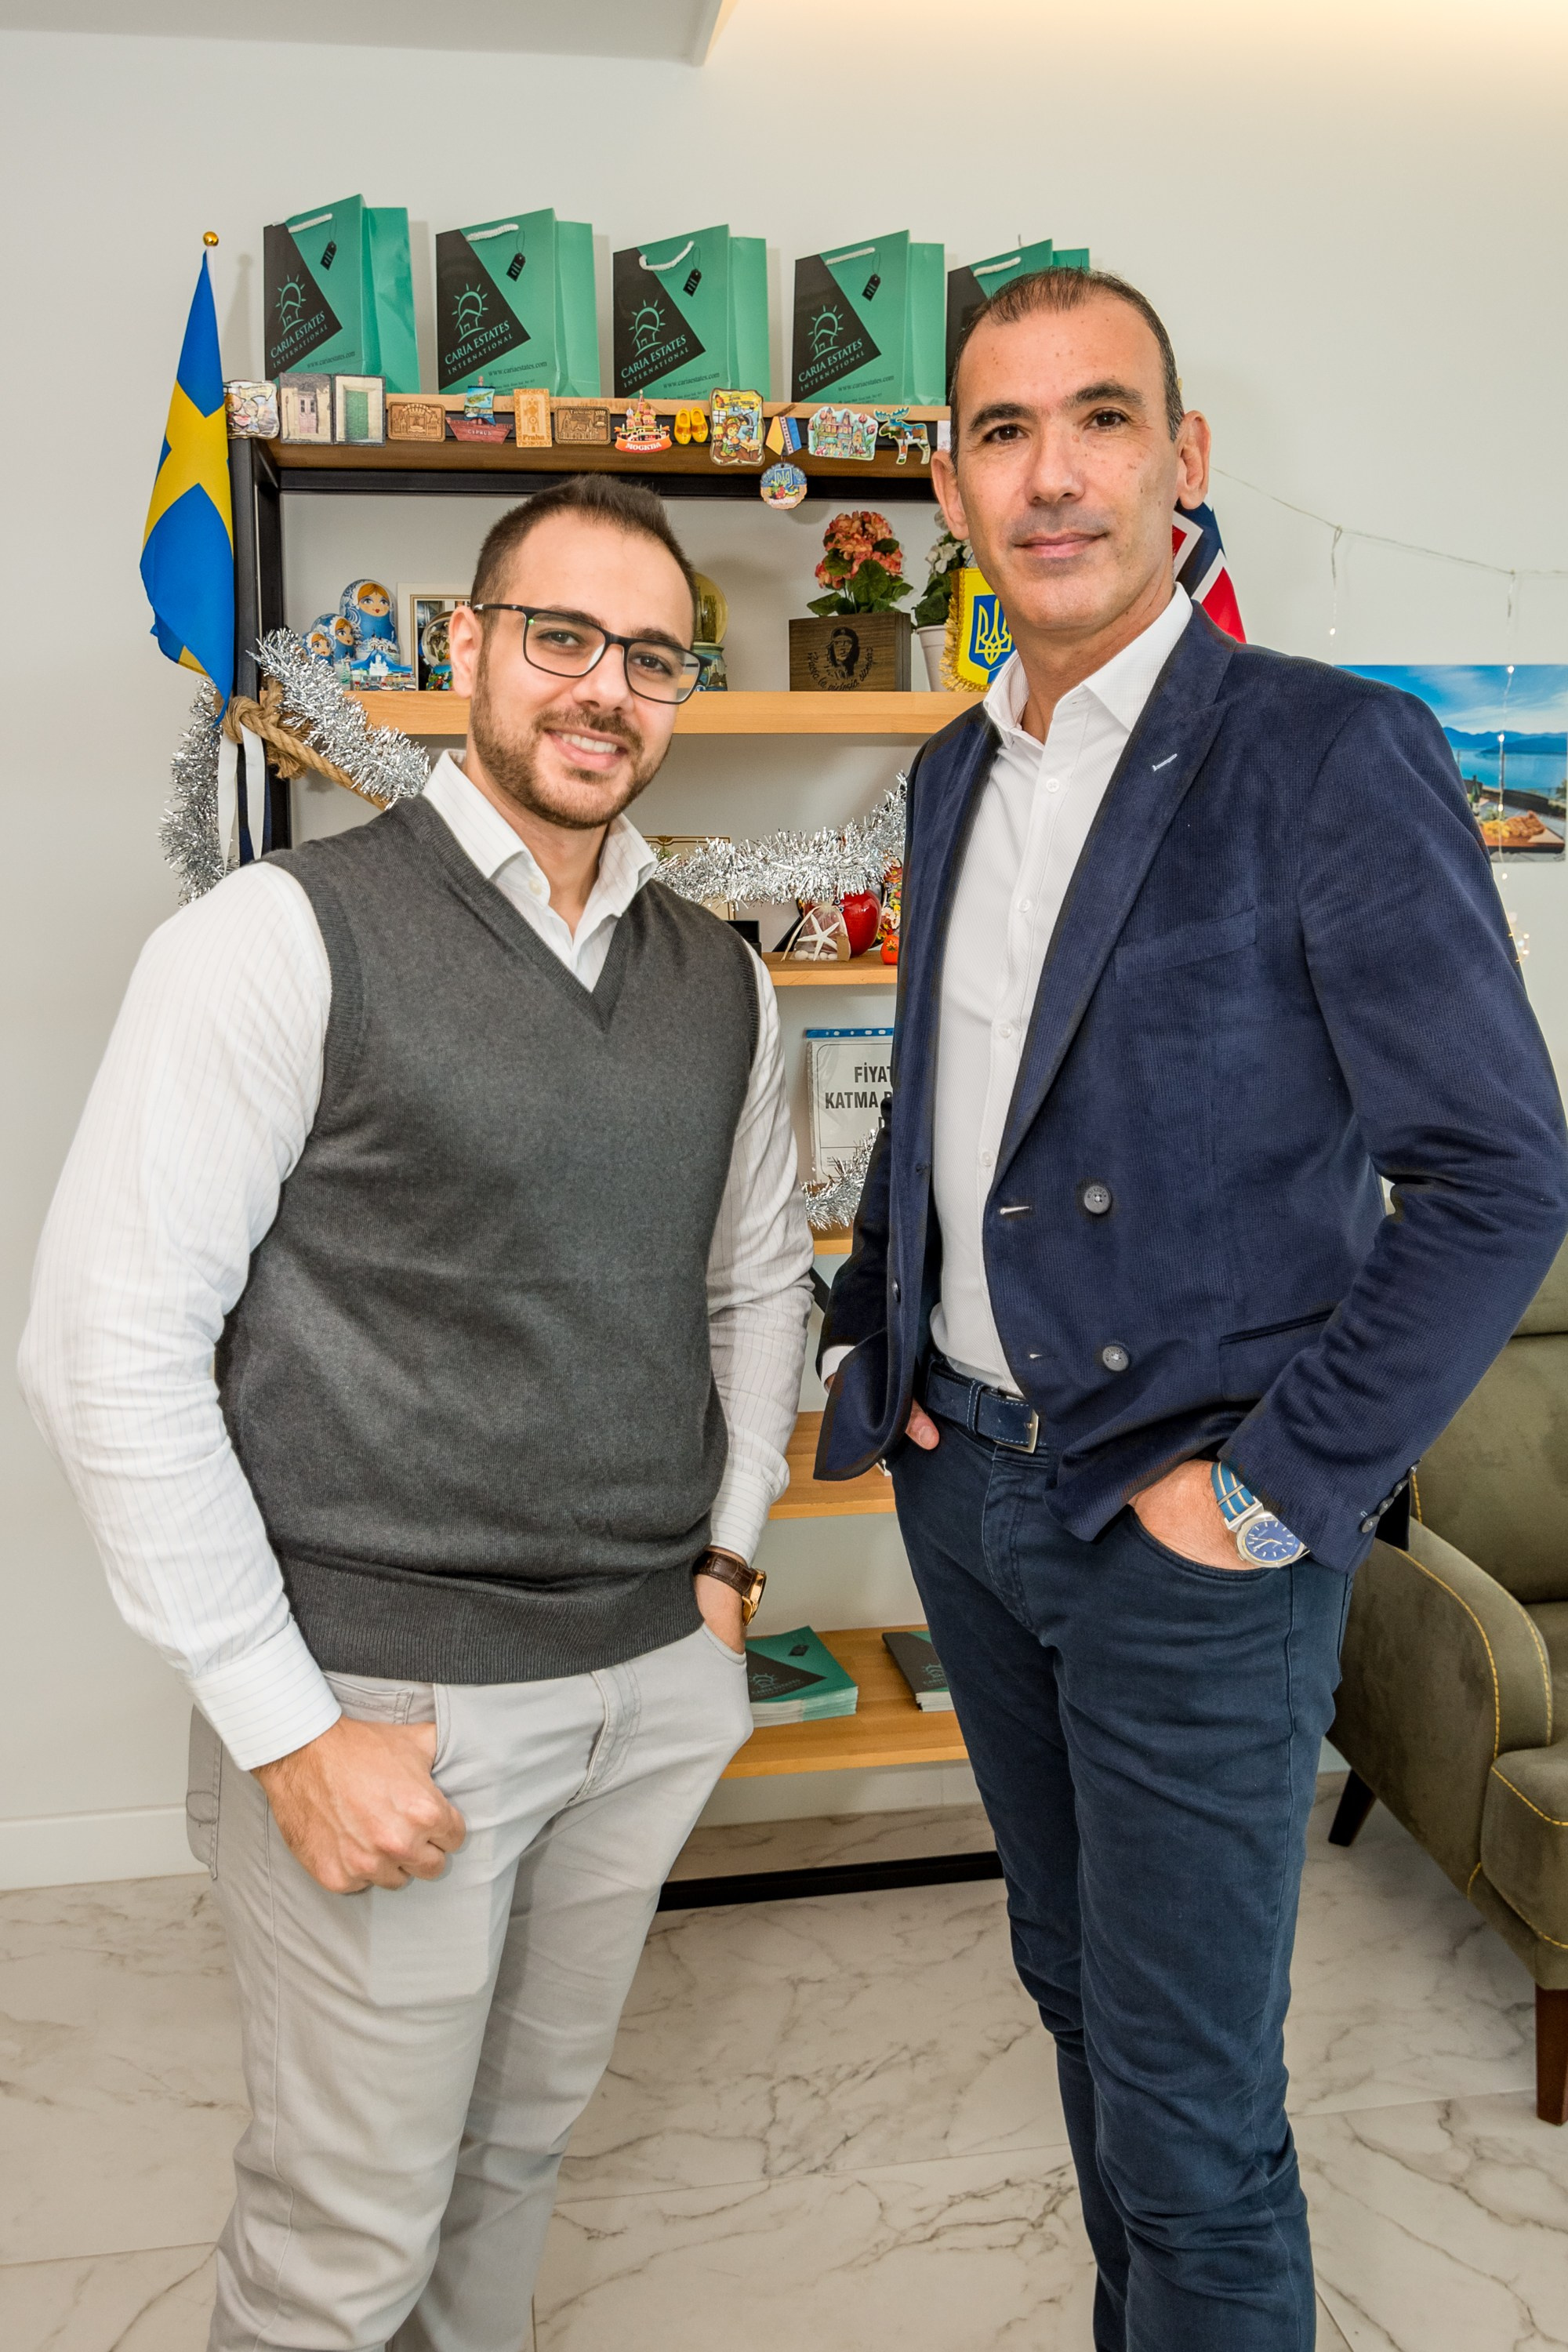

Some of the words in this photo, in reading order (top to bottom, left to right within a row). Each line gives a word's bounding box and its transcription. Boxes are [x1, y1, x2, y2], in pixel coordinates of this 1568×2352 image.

[270, 335, 295, 358] CARIA
[295, 310, 325, 341] ESTATES
[273, 324, 328, 368] INTERNATIONAL
[445, 343, 474, 365] CARIA
[473, 320, 510, 349] ESTATES
[448, 333, 513, 375] INTERNATIONAL
[621, 357, 650, 378] CARIA
[650, 334, 687, 362] ESTATES
[623, 347, 689, 388] INTERNATIONAL
[798, 361, 826, 383] CARIA
[827, 338, 862, 366] ESTATES
[800, 350, 865, 392] INTERNATIONAL
[626, 441, 662, 452] МОСКВА
[825, 1091, 879, 1109] KATMA
